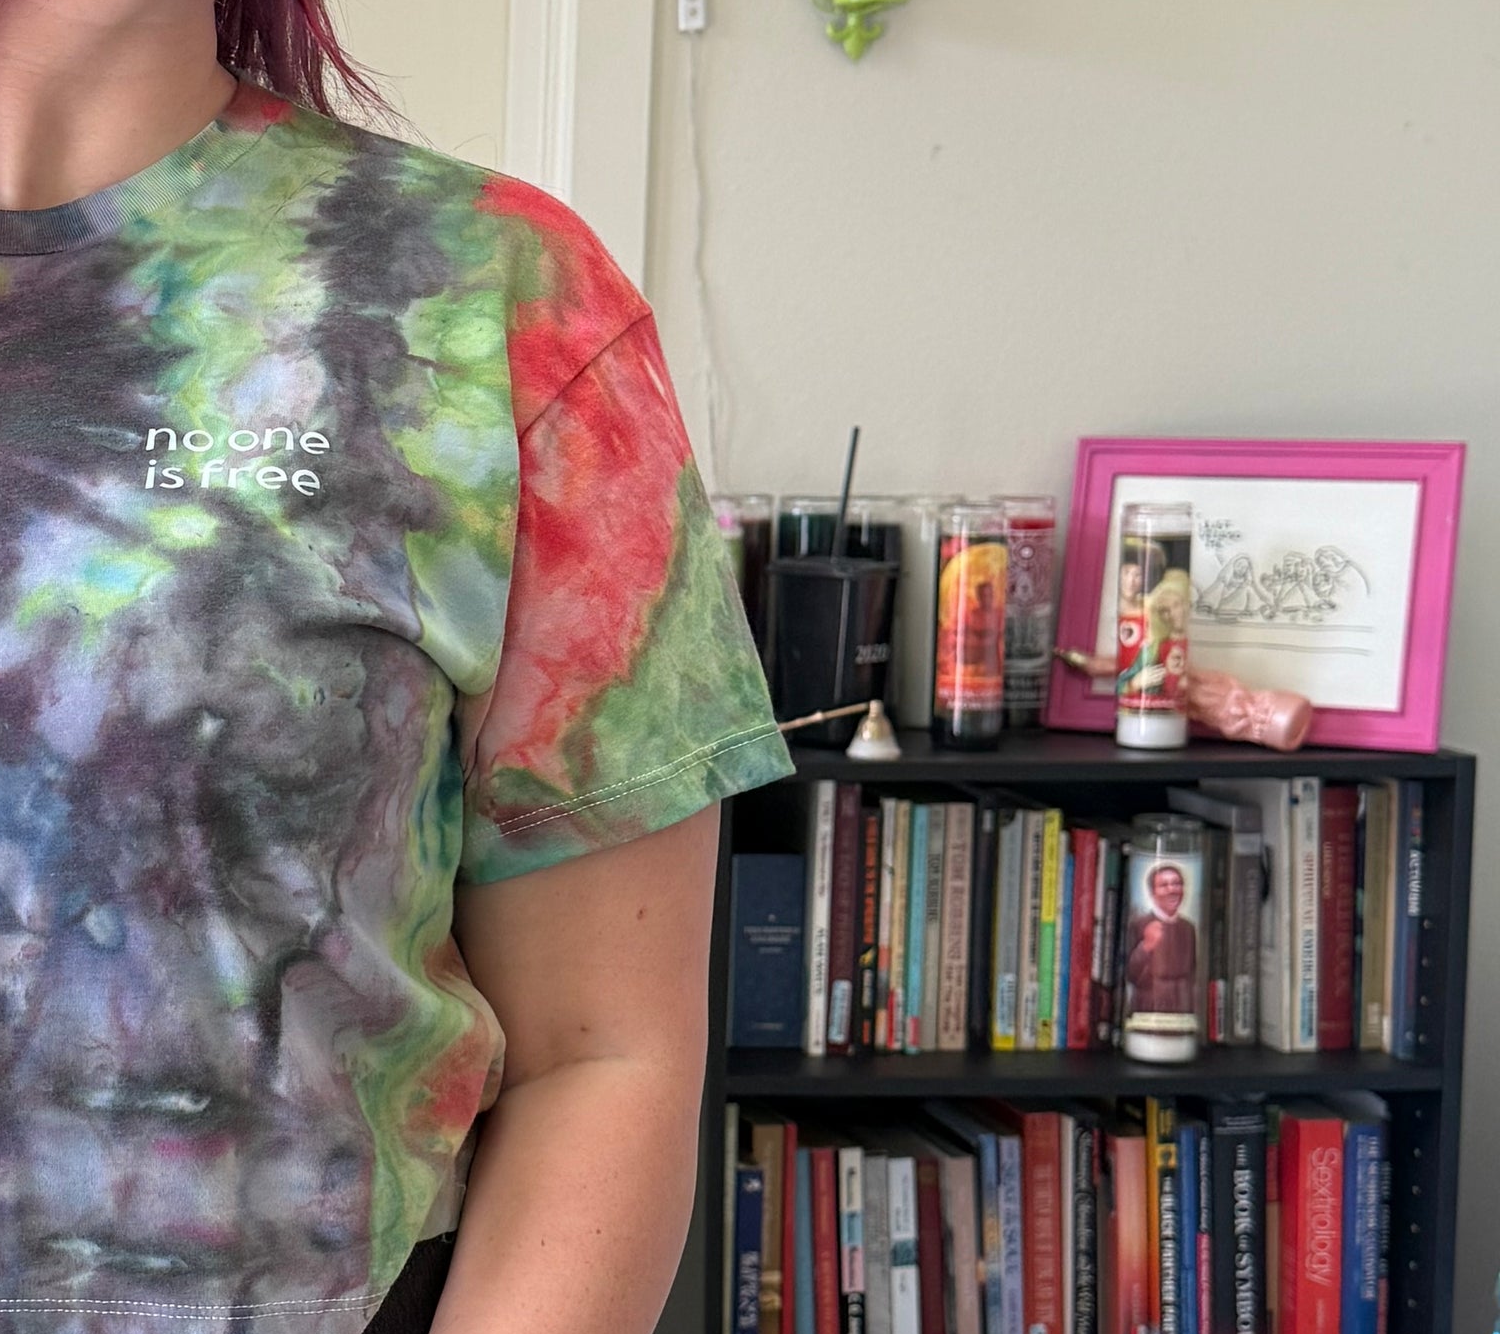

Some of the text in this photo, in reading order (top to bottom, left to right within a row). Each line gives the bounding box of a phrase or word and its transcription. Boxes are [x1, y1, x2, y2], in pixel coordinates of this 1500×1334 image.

[145, 426, 331, 455] no one
[145, 458, 321, 497] is free
[1235, 1144, 1247, 1166] THE
[1233, 1169, 1252, 1235] BOOK
[1305, 1146, 1341, 1288] Sextrology
